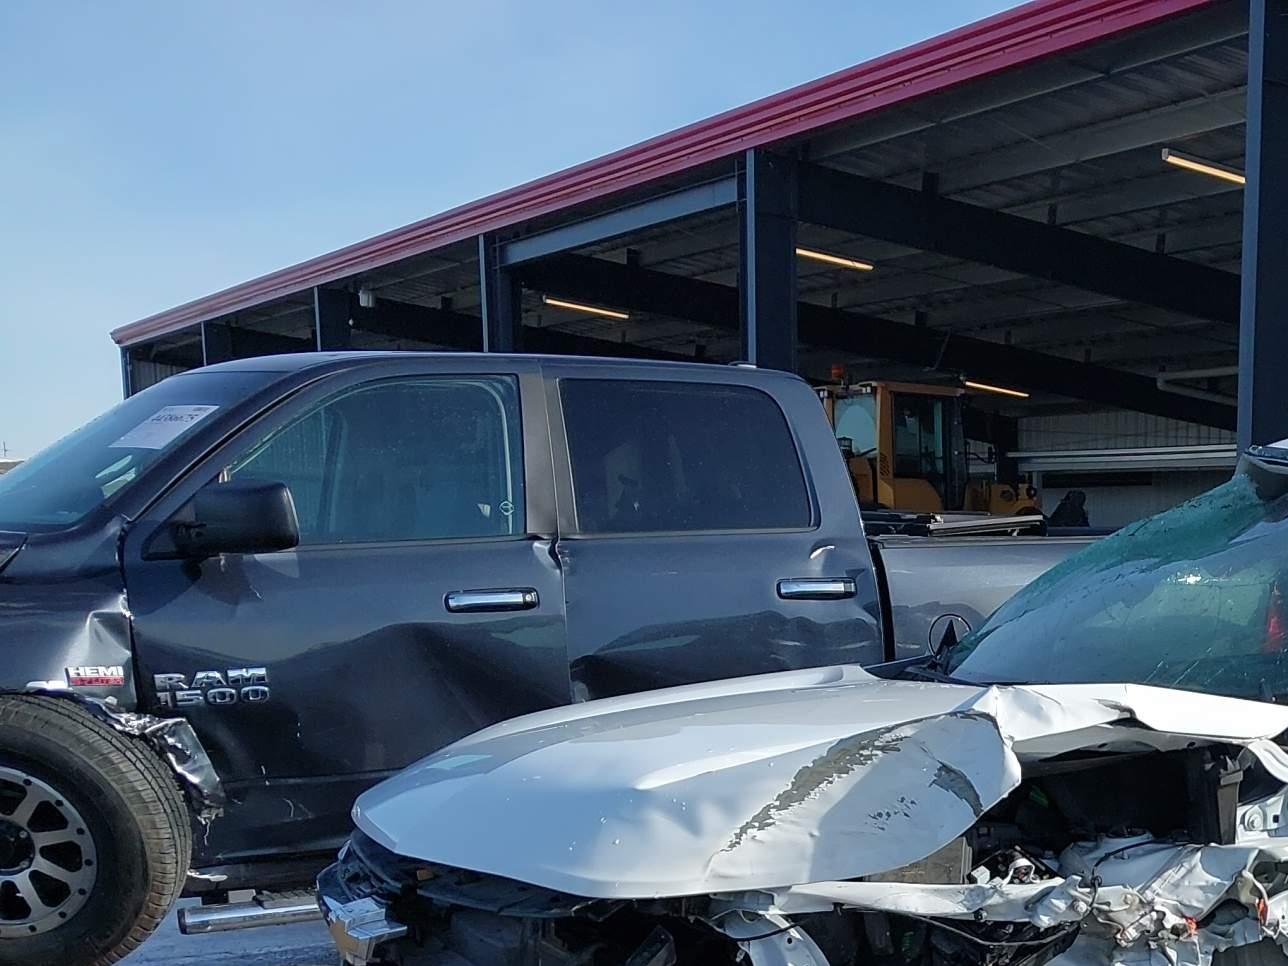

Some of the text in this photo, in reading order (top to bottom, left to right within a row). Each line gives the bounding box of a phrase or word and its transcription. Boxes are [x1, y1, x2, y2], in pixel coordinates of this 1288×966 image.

[69, 666, 123, 676] HEMI
[154, 668, 268, 690] RAM
[156, 686, 270, 708] 1500
